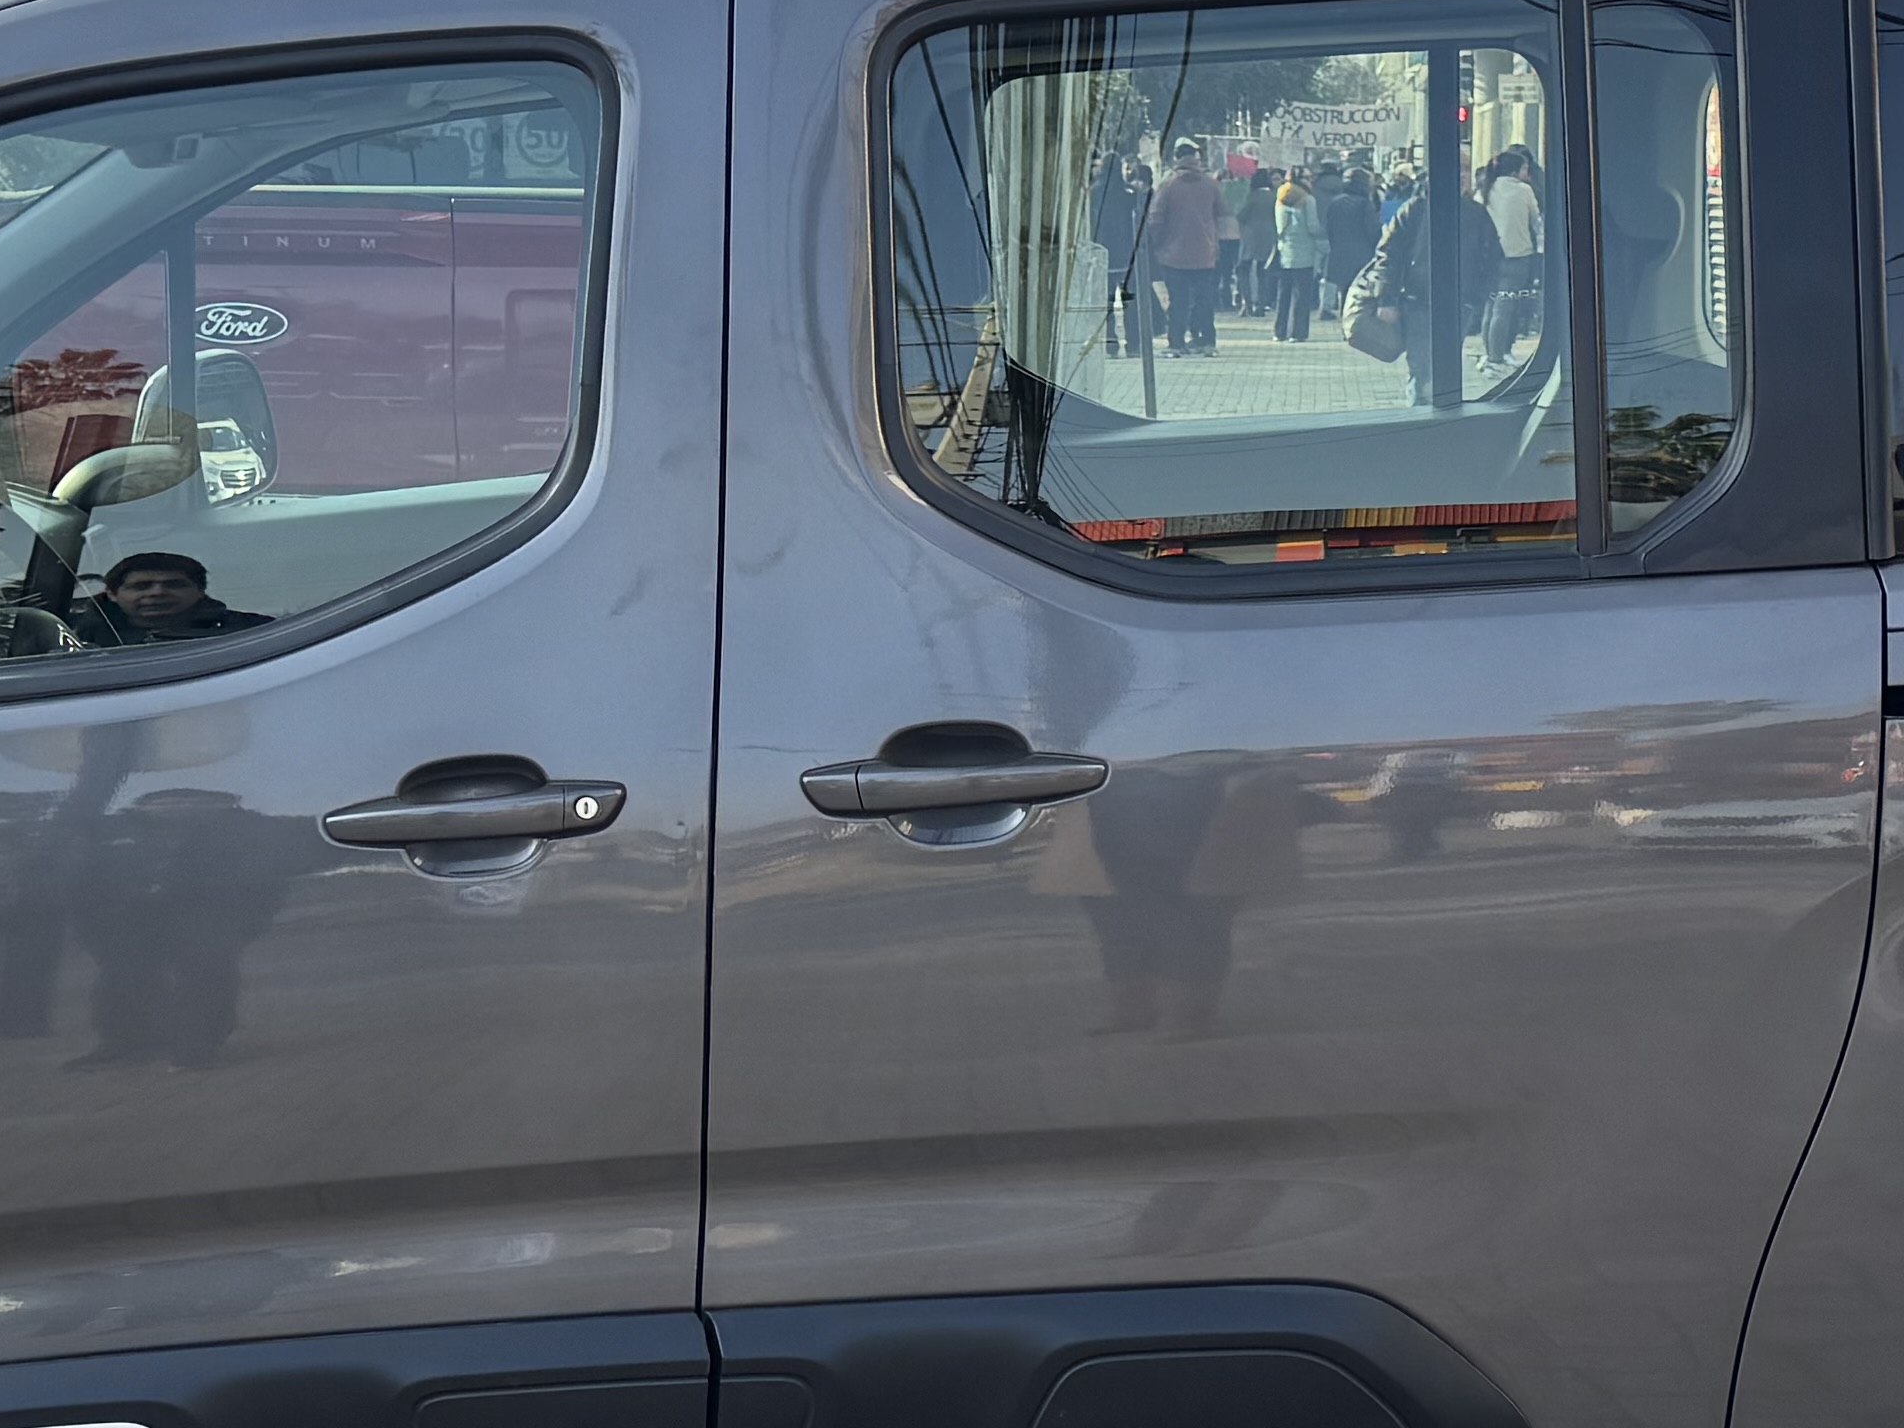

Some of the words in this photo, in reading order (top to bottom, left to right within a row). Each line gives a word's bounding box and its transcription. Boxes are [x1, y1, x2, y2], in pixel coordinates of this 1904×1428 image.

[1312, 131, 1377, 146] VERDAD
[202, 234, 377, 250] TINUM
[199, 306, 269, 339] Ford
